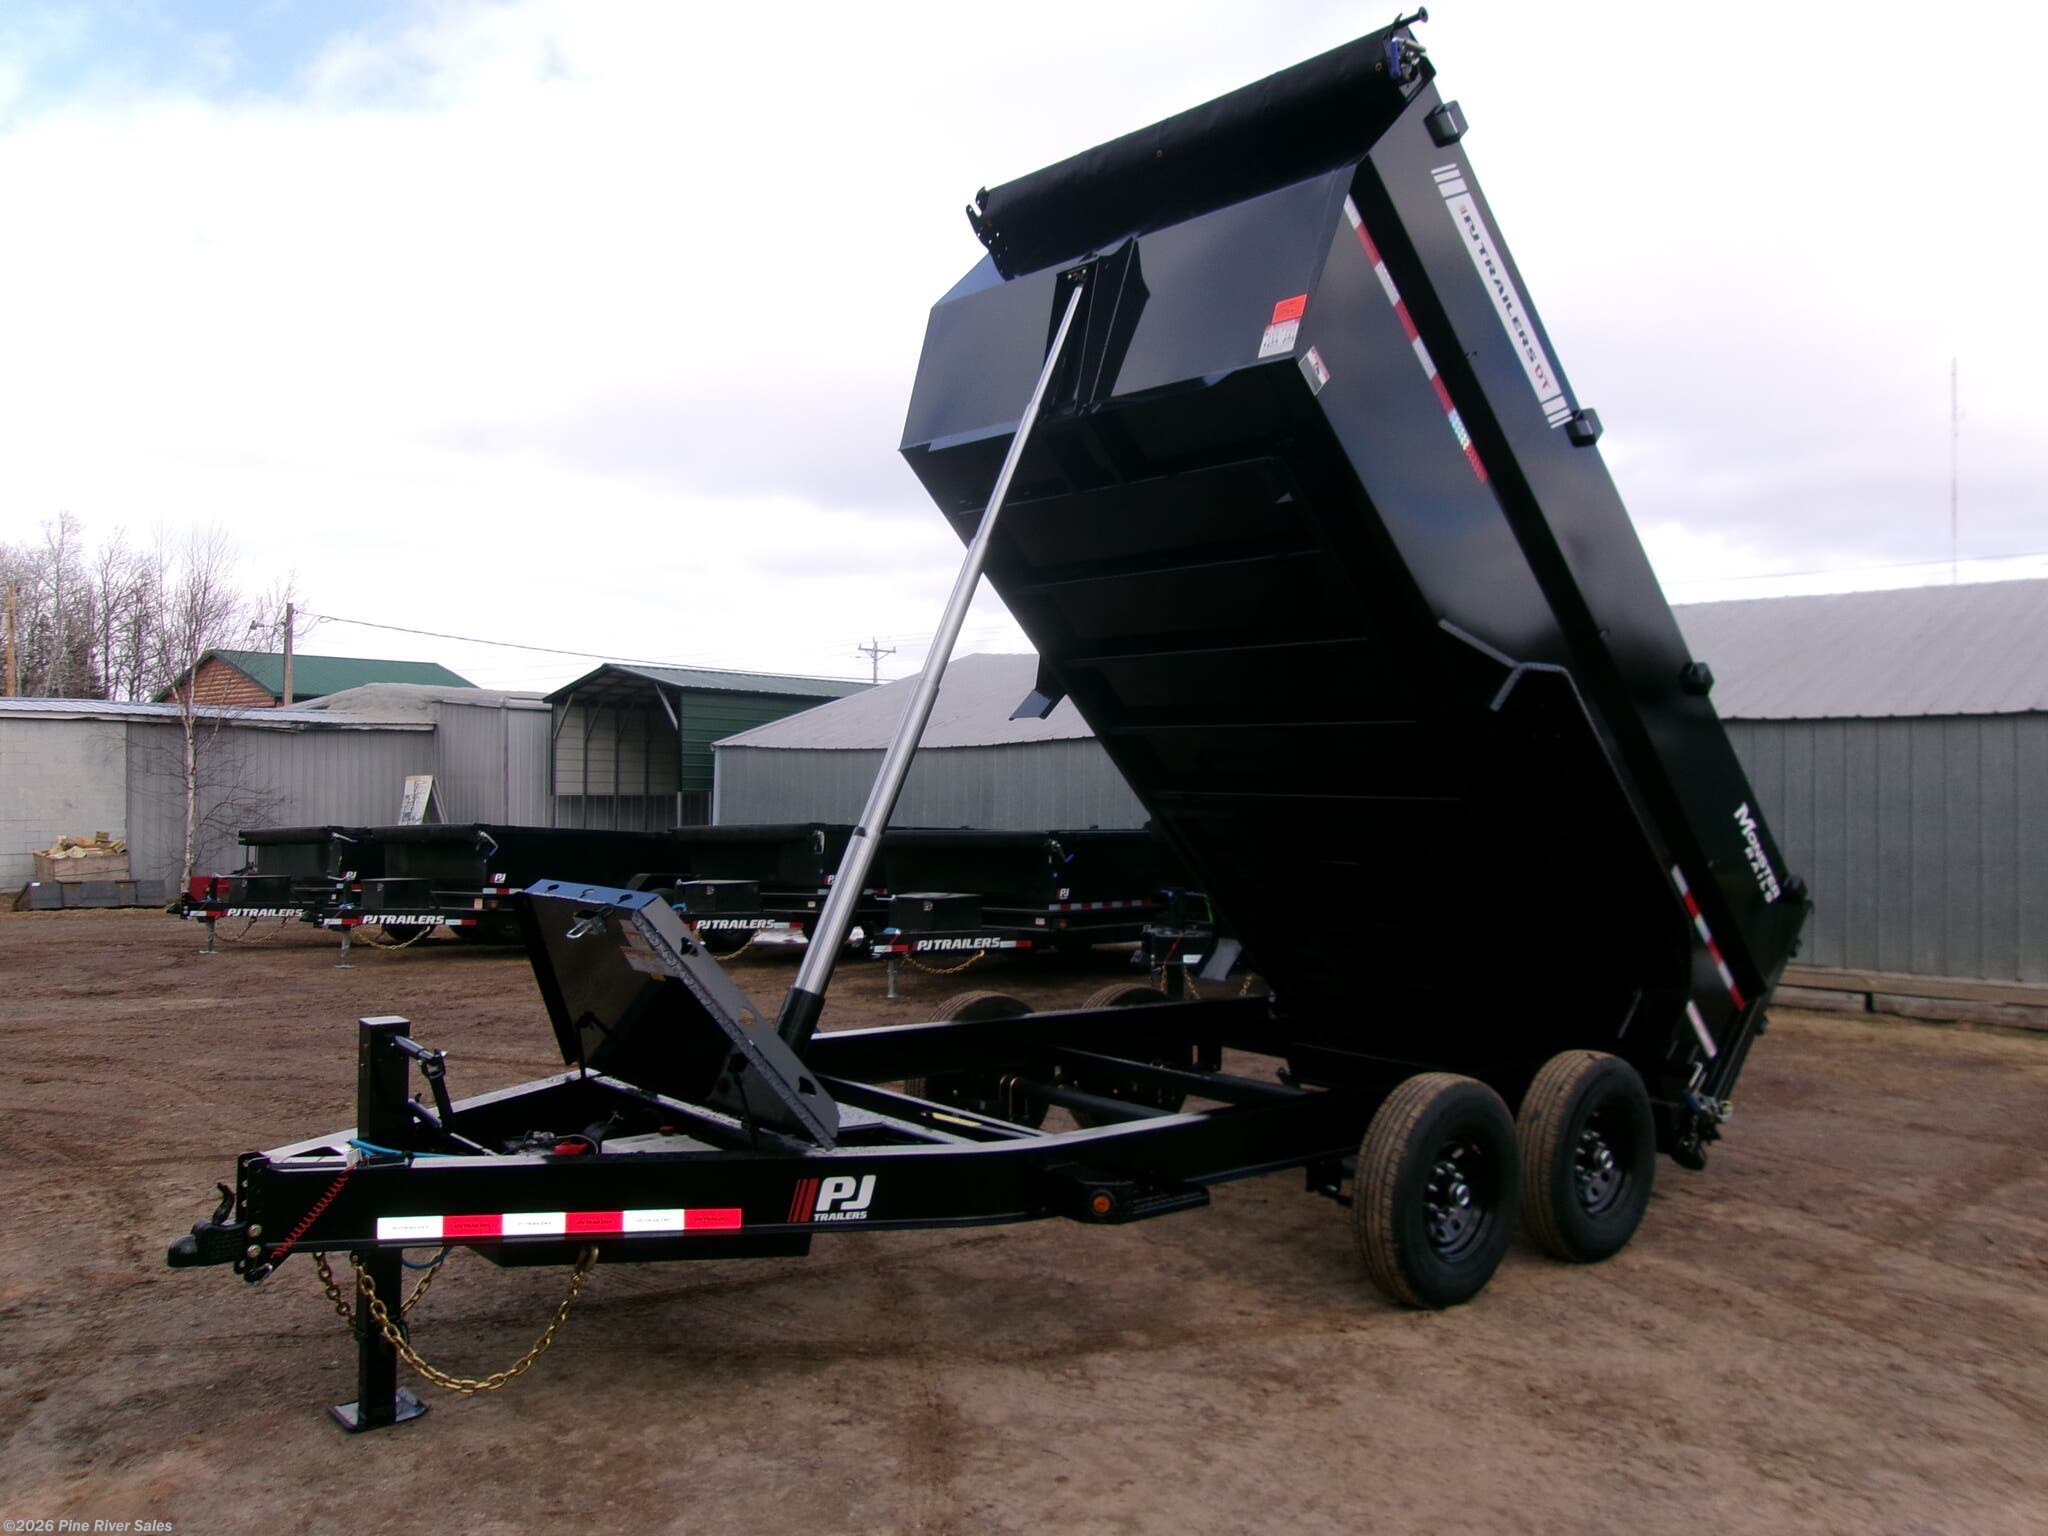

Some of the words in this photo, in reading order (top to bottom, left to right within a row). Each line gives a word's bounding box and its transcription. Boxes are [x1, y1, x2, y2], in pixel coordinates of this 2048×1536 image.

[495, 873, 506, 881] PJ
[1744, 846, 1774, 904] RAILS
[1060, 888, 1069, 896] PJ
[816, 1175, 876, 1211] PJ
[814, 1211, 867, 1222] TRAILERS
